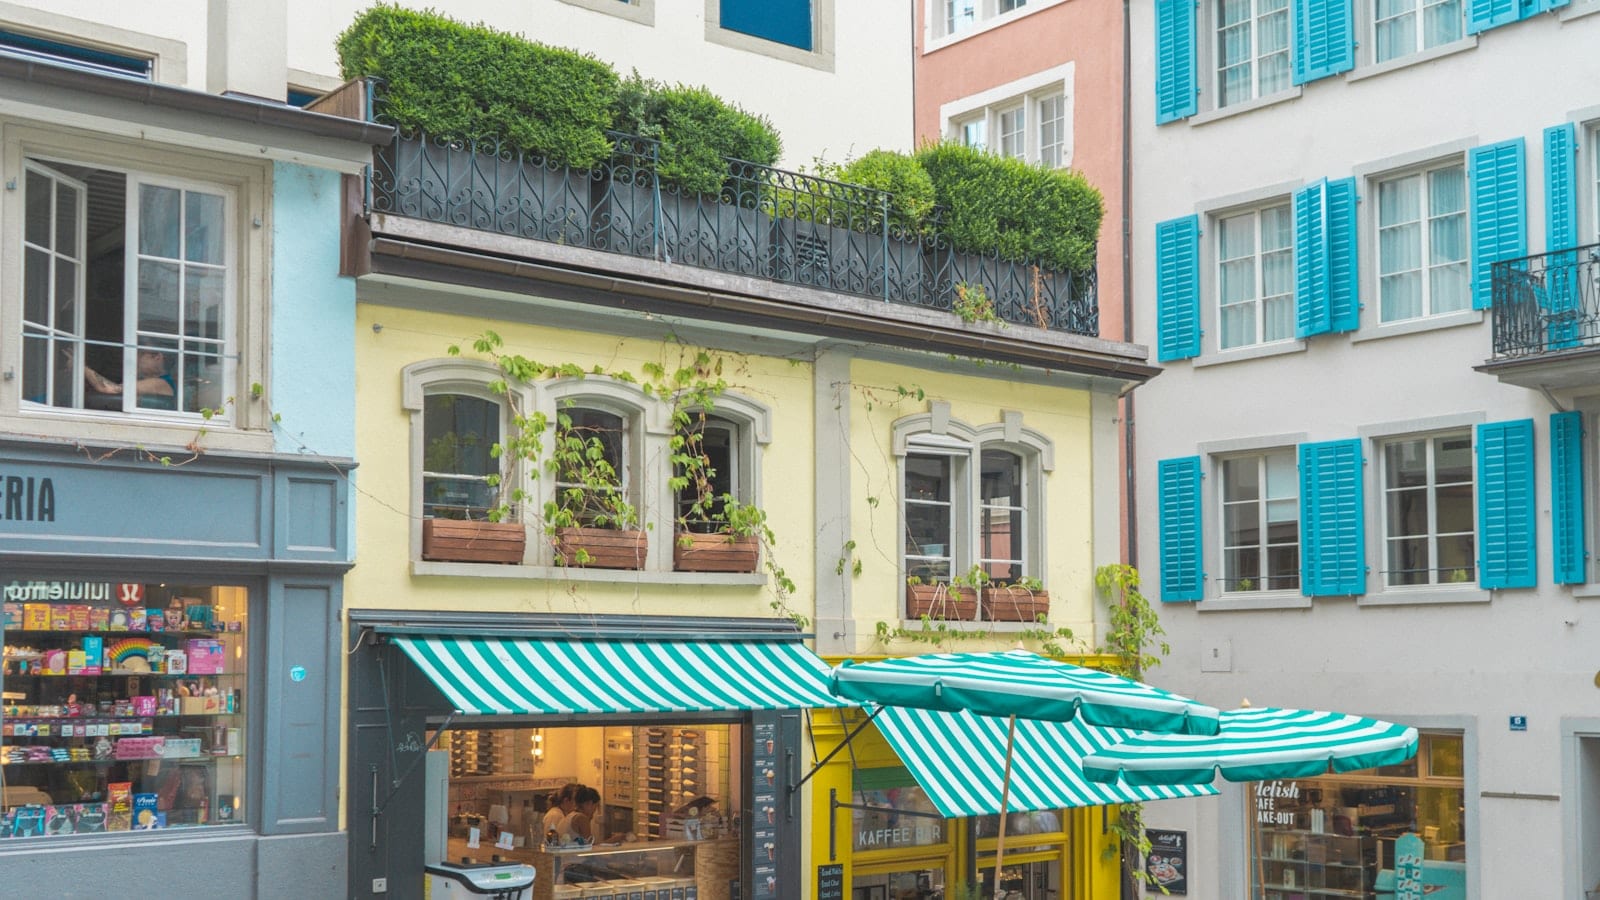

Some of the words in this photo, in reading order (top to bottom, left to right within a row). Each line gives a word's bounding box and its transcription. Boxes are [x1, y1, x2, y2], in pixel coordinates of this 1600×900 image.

[0, 475, 55, 522] RIA
[1255, 797, 1275, 811] AFE
[1257, 811, 1295, 825] AKE-OUT
[859, 827, 910, 846] KAFFEE
